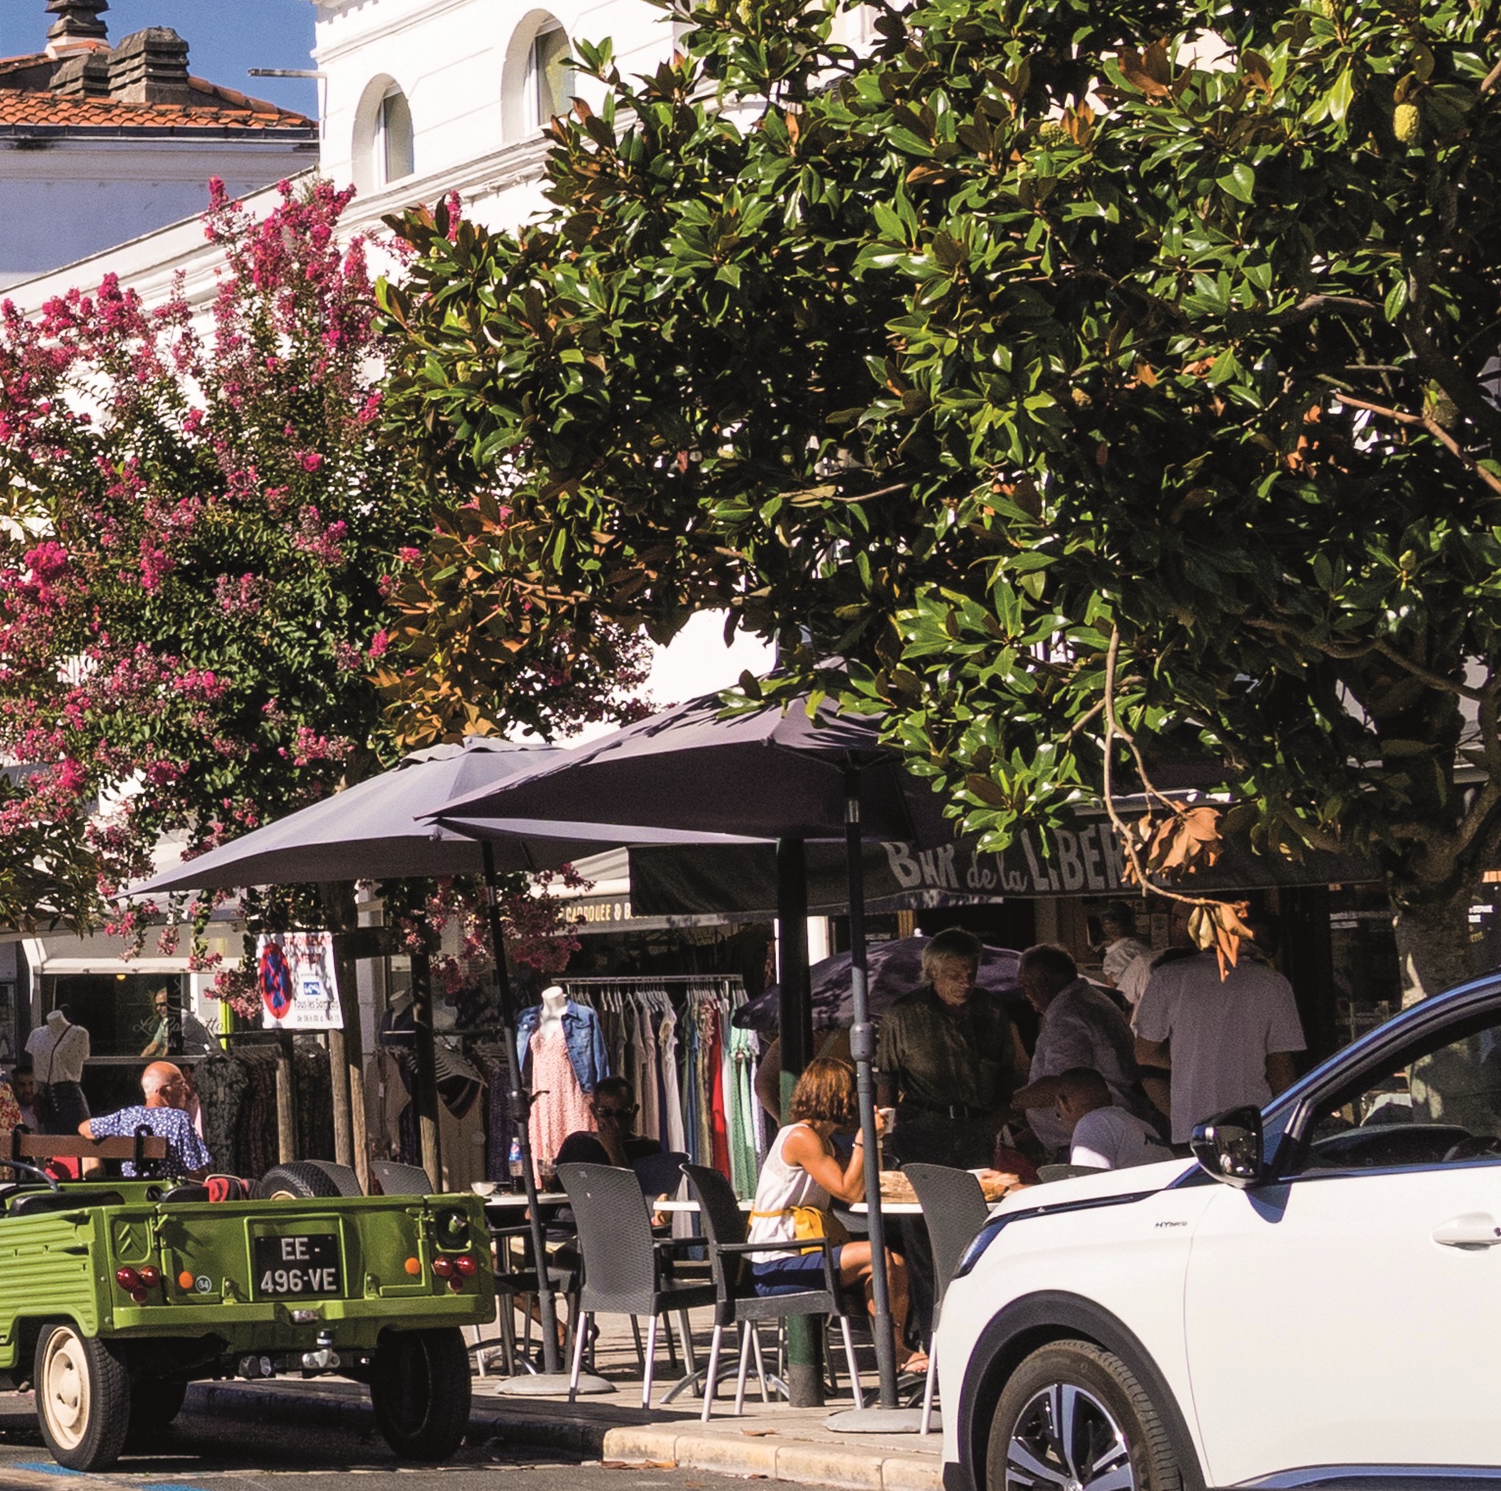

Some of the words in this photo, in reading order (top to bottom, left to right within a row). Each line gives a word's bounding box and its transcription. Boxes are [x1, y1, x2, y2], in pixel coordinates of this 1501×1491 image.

[880, 841, 959, 889] BAR
[967, 849, 998, 890] de
[997, 852, 1028, 892] la
[260, 1268, 337, 1293] 496-VE
